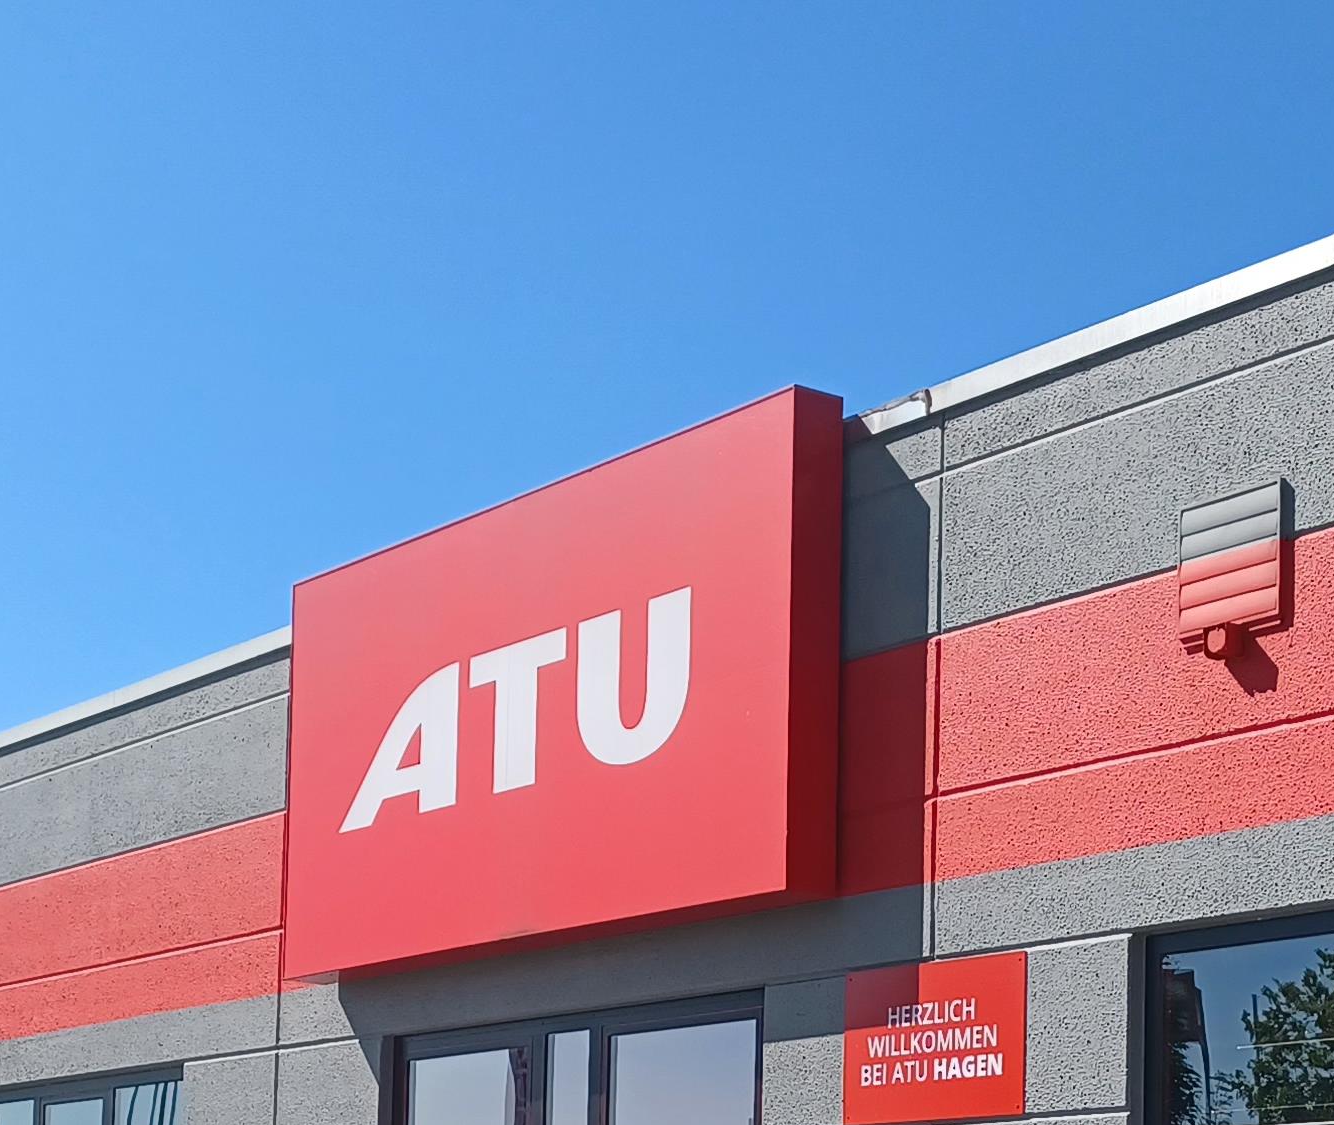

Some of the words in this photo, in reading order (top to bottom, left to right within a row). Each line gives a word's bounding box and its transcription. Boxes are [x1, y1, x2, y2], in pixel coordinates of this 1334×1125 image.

[338, 586, 691, 833] ATU
[886, 997, 976, 1029] HERZLICH
[867, 1023, 998, 1058] WILLKOMMEN
[860, 1062, 887, 1087] BEI
[891, 1060, 929, 1084] ATU
[932, 1053, 1004, 1081] HAGEN
